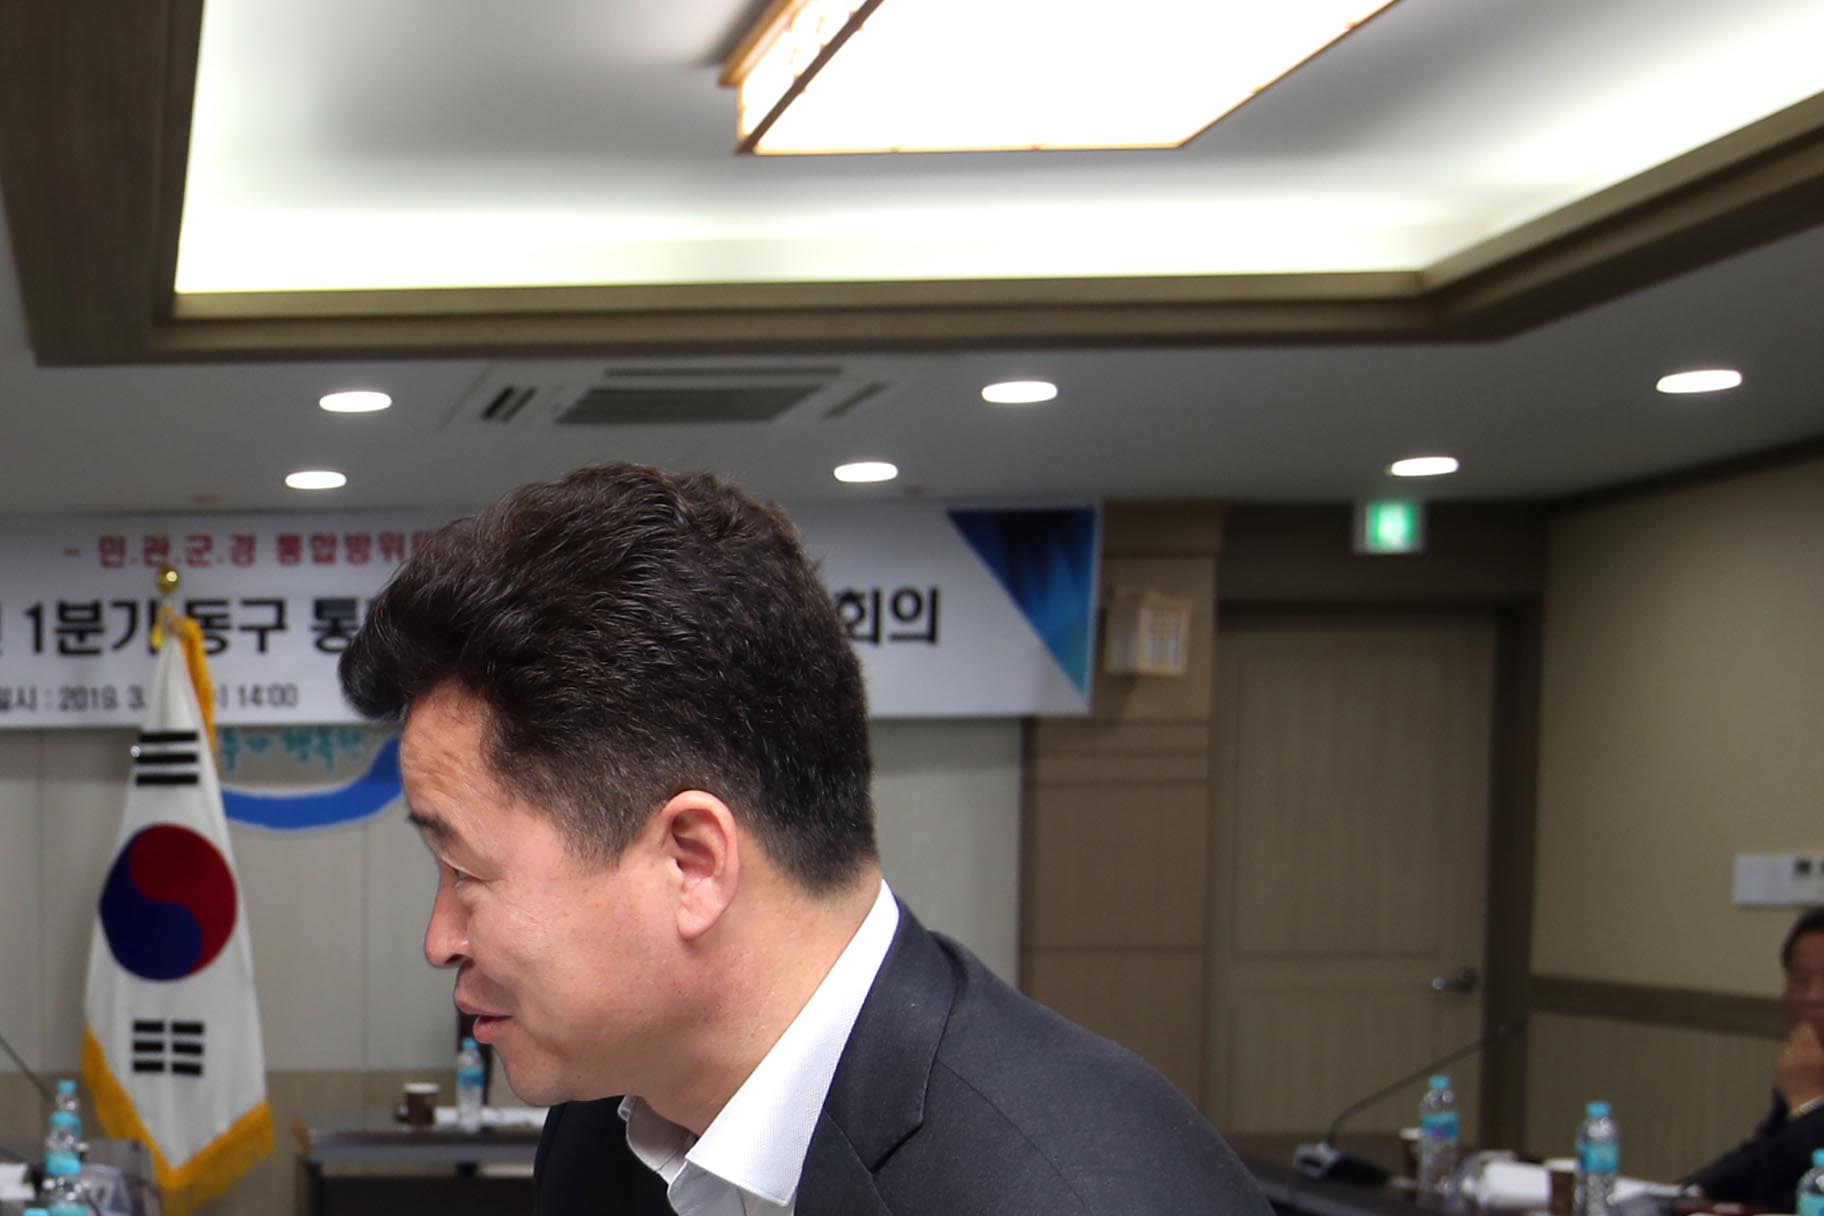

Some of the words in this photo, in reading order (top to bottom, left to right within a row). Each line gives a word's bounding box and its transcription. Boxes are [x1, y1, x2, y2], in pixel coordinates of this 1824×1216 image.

[24, 599, 159, 656] 1분기
[185, 598, 288, 656] 동구
[835, 584, 942, 646] 회의
